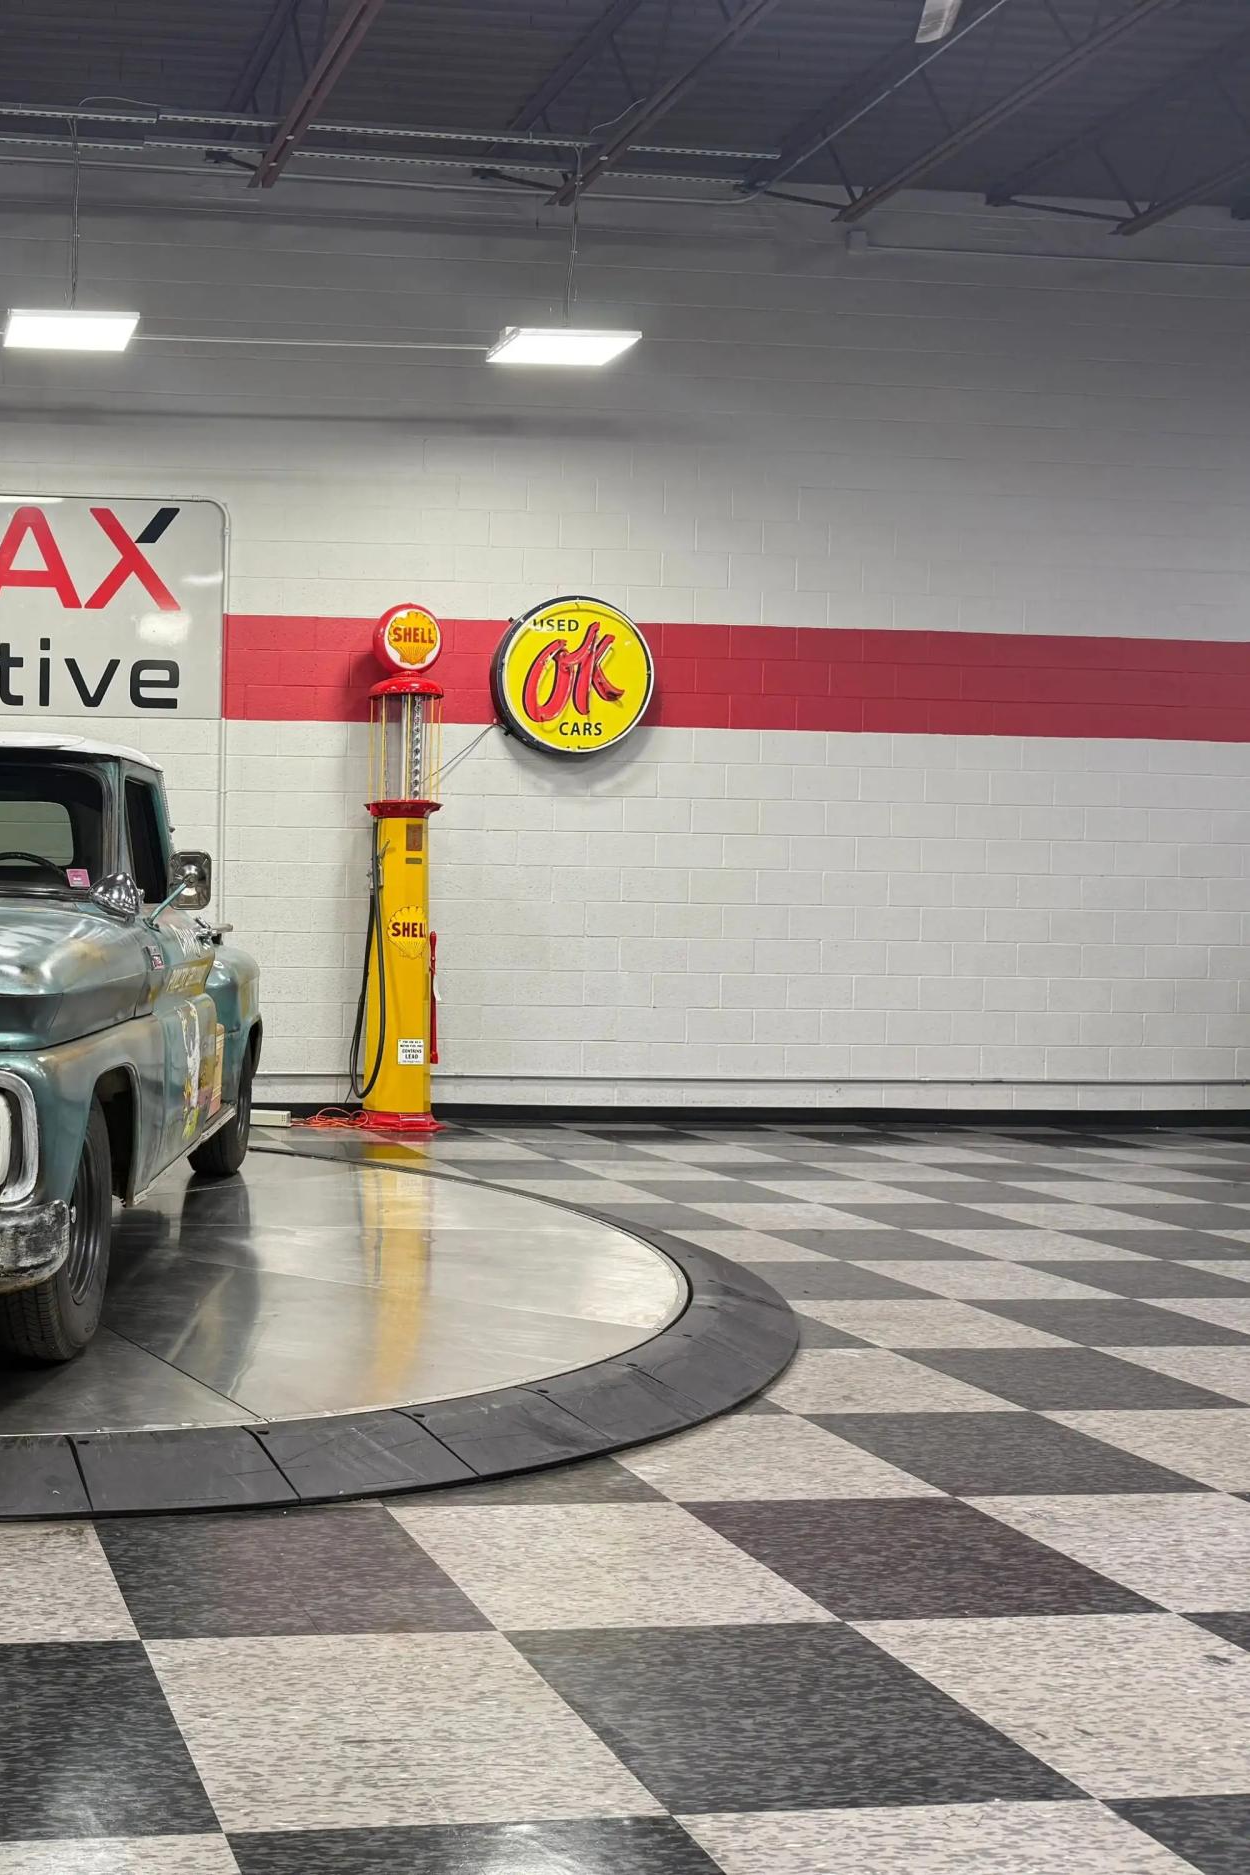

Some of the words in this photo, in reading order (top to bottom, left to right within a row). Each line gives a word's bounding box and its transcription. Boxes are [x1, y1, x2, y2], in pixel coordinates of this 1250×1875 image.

[533, 618, 580, 633] USED
[392, 626, 435, 645] SHELL
[522, 620, 625, 723] OK
[559, 721, 603, 737] CARS
[391, 921, 426, 938] SHELL
